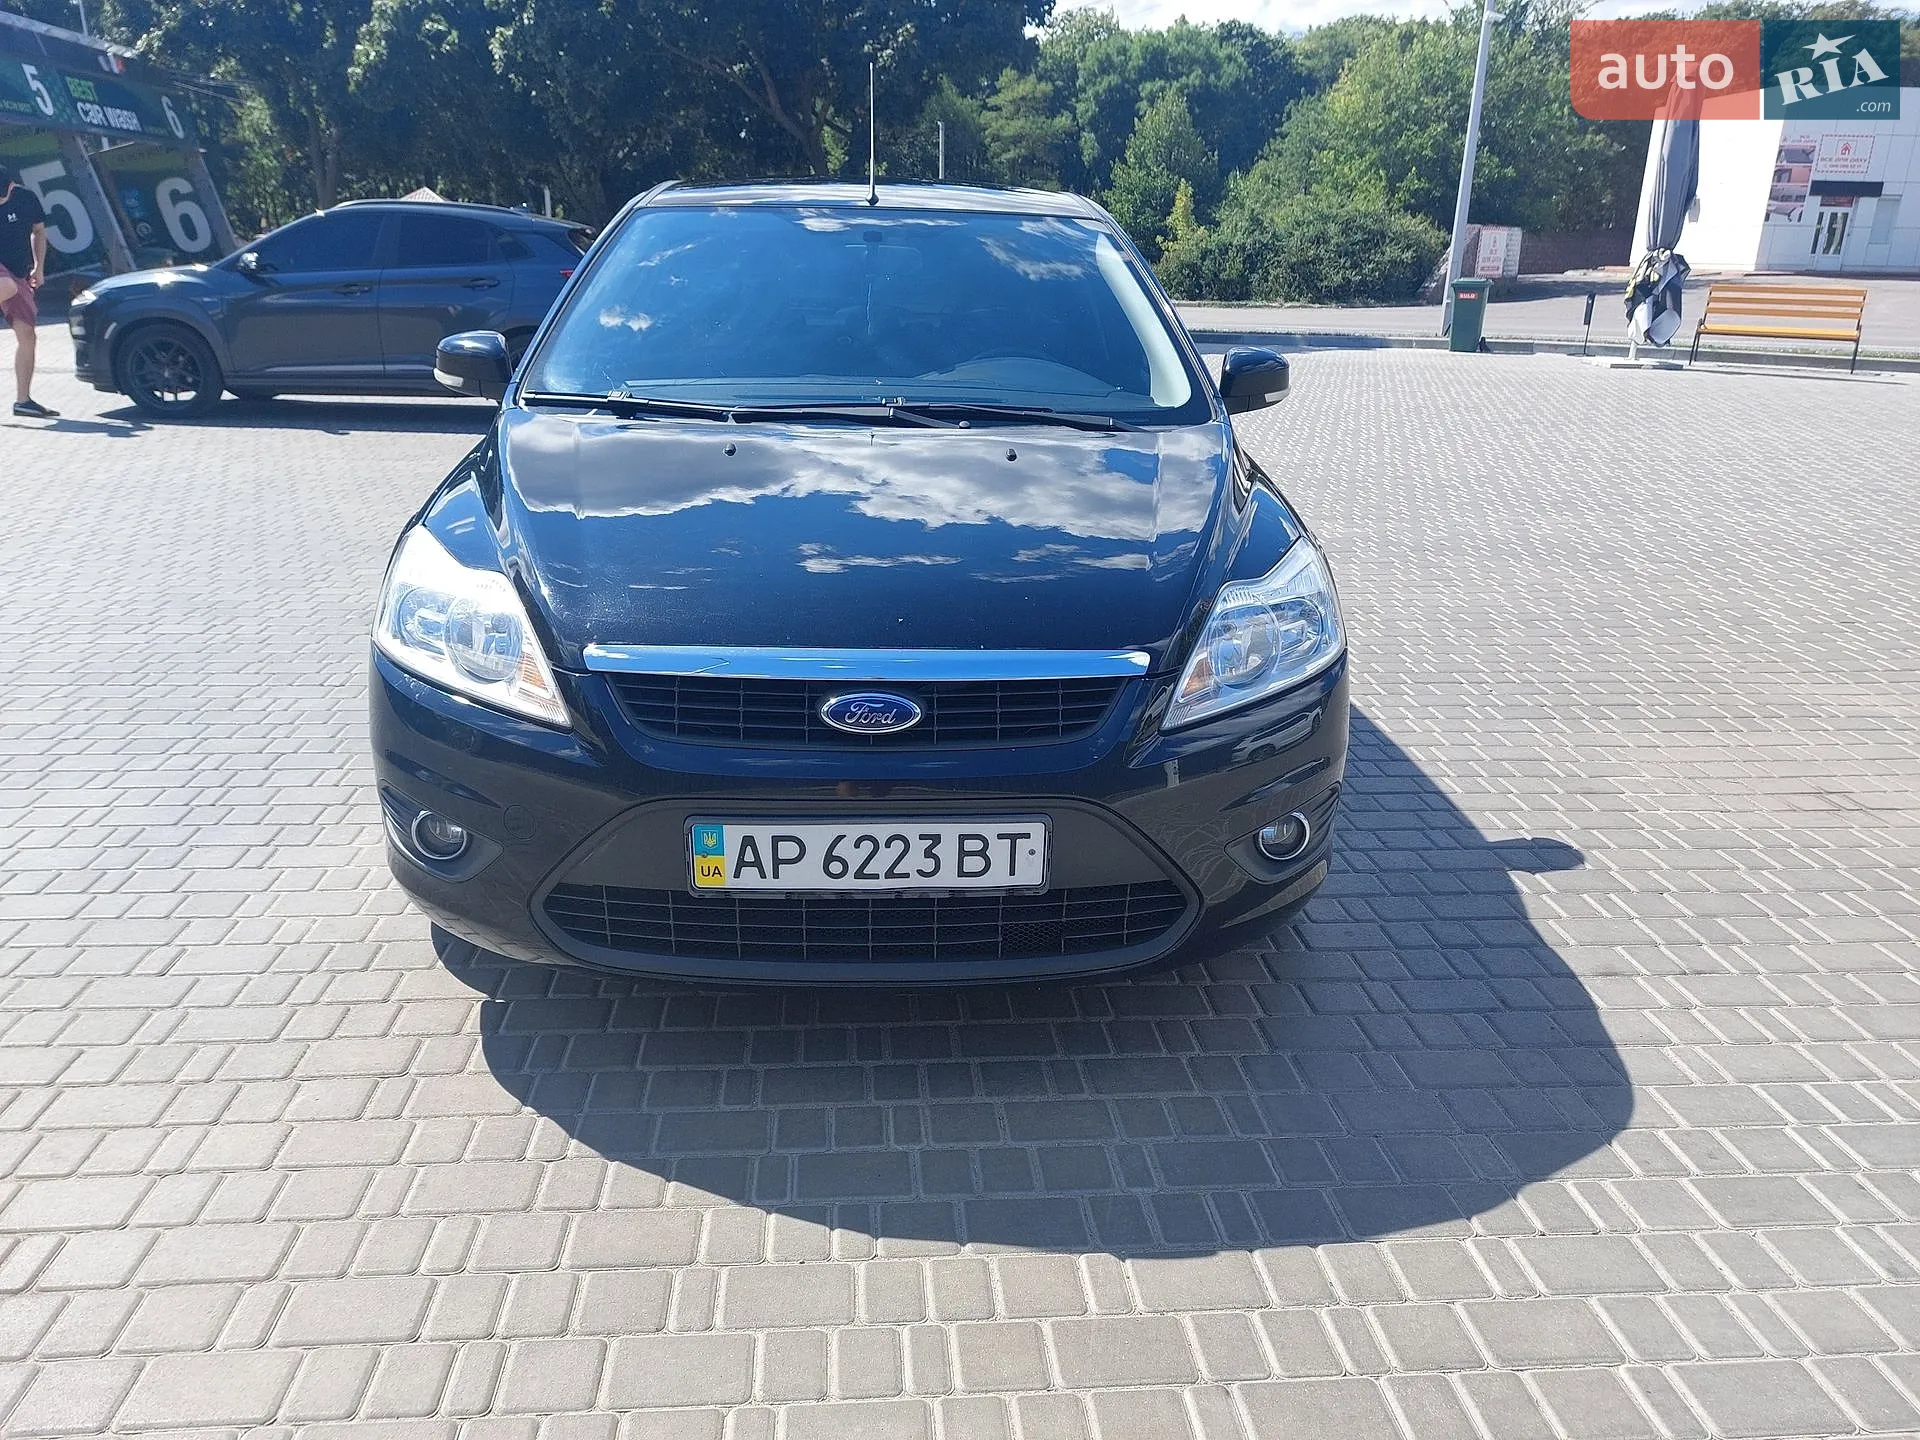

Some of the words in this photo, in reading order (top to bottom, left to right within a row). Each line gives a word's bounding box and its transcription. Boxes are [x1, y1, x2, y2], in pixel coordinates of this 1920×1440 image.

[21, 63, 54, 116] 5
[161, 95, 184, 139] 6
[19, 160, 94, 254] 5
[156, 176, 212, 253] 6
[844, 701, 898, 724] Ford
[700, 865, 723, 879] UA
[733, 834, 807, 880] AP
[822, 833, 942, 880] 6223
[956, 832, 1032, 879] BT
